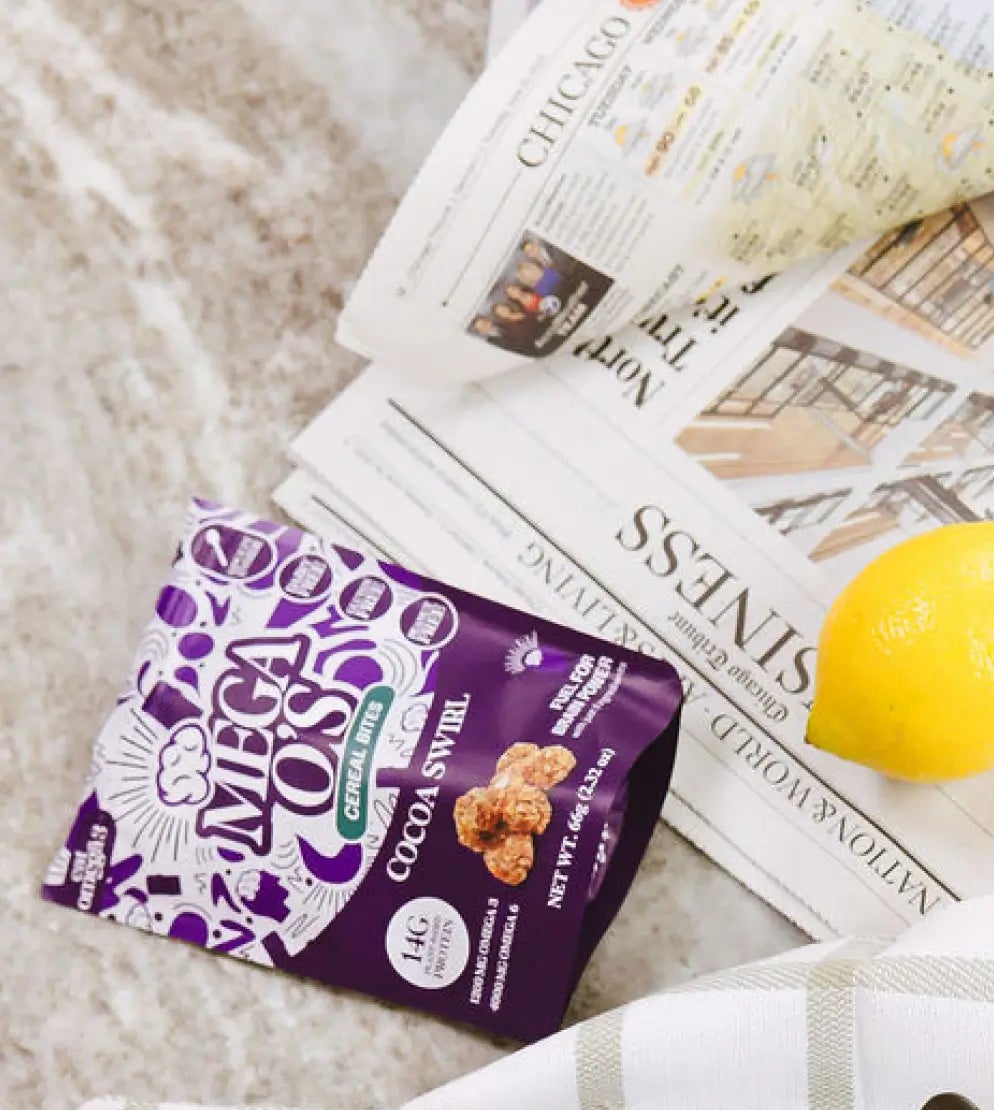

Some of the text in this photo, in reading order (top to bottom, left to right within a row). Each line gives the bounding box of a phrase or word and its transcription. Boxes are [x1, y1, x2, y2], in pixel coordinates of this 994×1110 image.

[516, 15, 631, 168] CHICAGO
[518, 541, 617, 631] LIVING
[615, 504, 818, 710] SINESS
[549, 653, 596, 711] FUEL FOR
[551, 655, 614, 737] BRAIN POWER
[668, 610, 788, 722] Chicago Tribune
[199, 637, 308, 852] MEGA
[272, 683, 353, 808] O'S
[344, 701, 384, 821] CEREAL BITES
[386, 786, 440, 882] COCOA
[422, 693, 471, 780] SWIRL
[576, 767, 604, 801] (2.32
[710, 713, 811, 809] WORLD
[556, 834, 579, 866] WT.
[567, 803, 589, 832] 66g
[812, 797, 836, 823] &
[547, 868, 569, 910] NET
[829, 816, 940, 914] NATION
[401, 914, 429, 961] 14G
